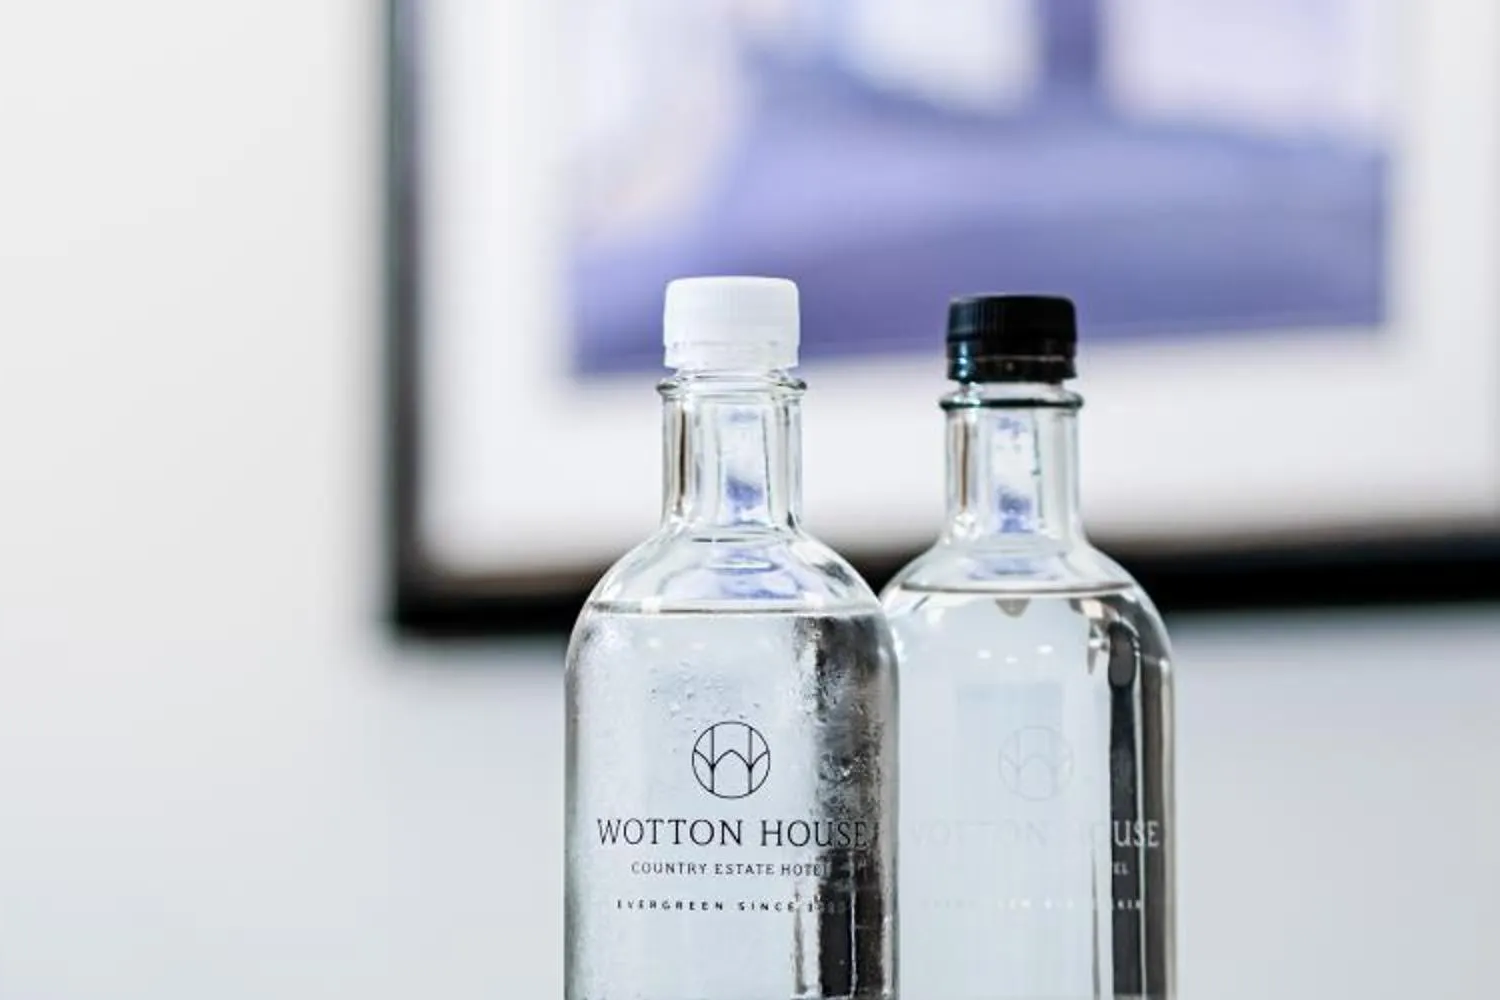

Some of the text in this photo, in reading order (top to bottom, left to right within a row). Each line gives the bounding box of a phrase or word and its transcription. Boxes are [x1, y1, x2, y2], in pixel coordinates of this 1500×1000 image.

[596, 817, 869, 849] WOTTON HOUSE
[630, 861, 708, 876] COUNTRY
[714, 863, 776, 876] ESTATE
[616, 899, 724, 912] EVERGREEN
[737, 901, 796, 914] SINCE
